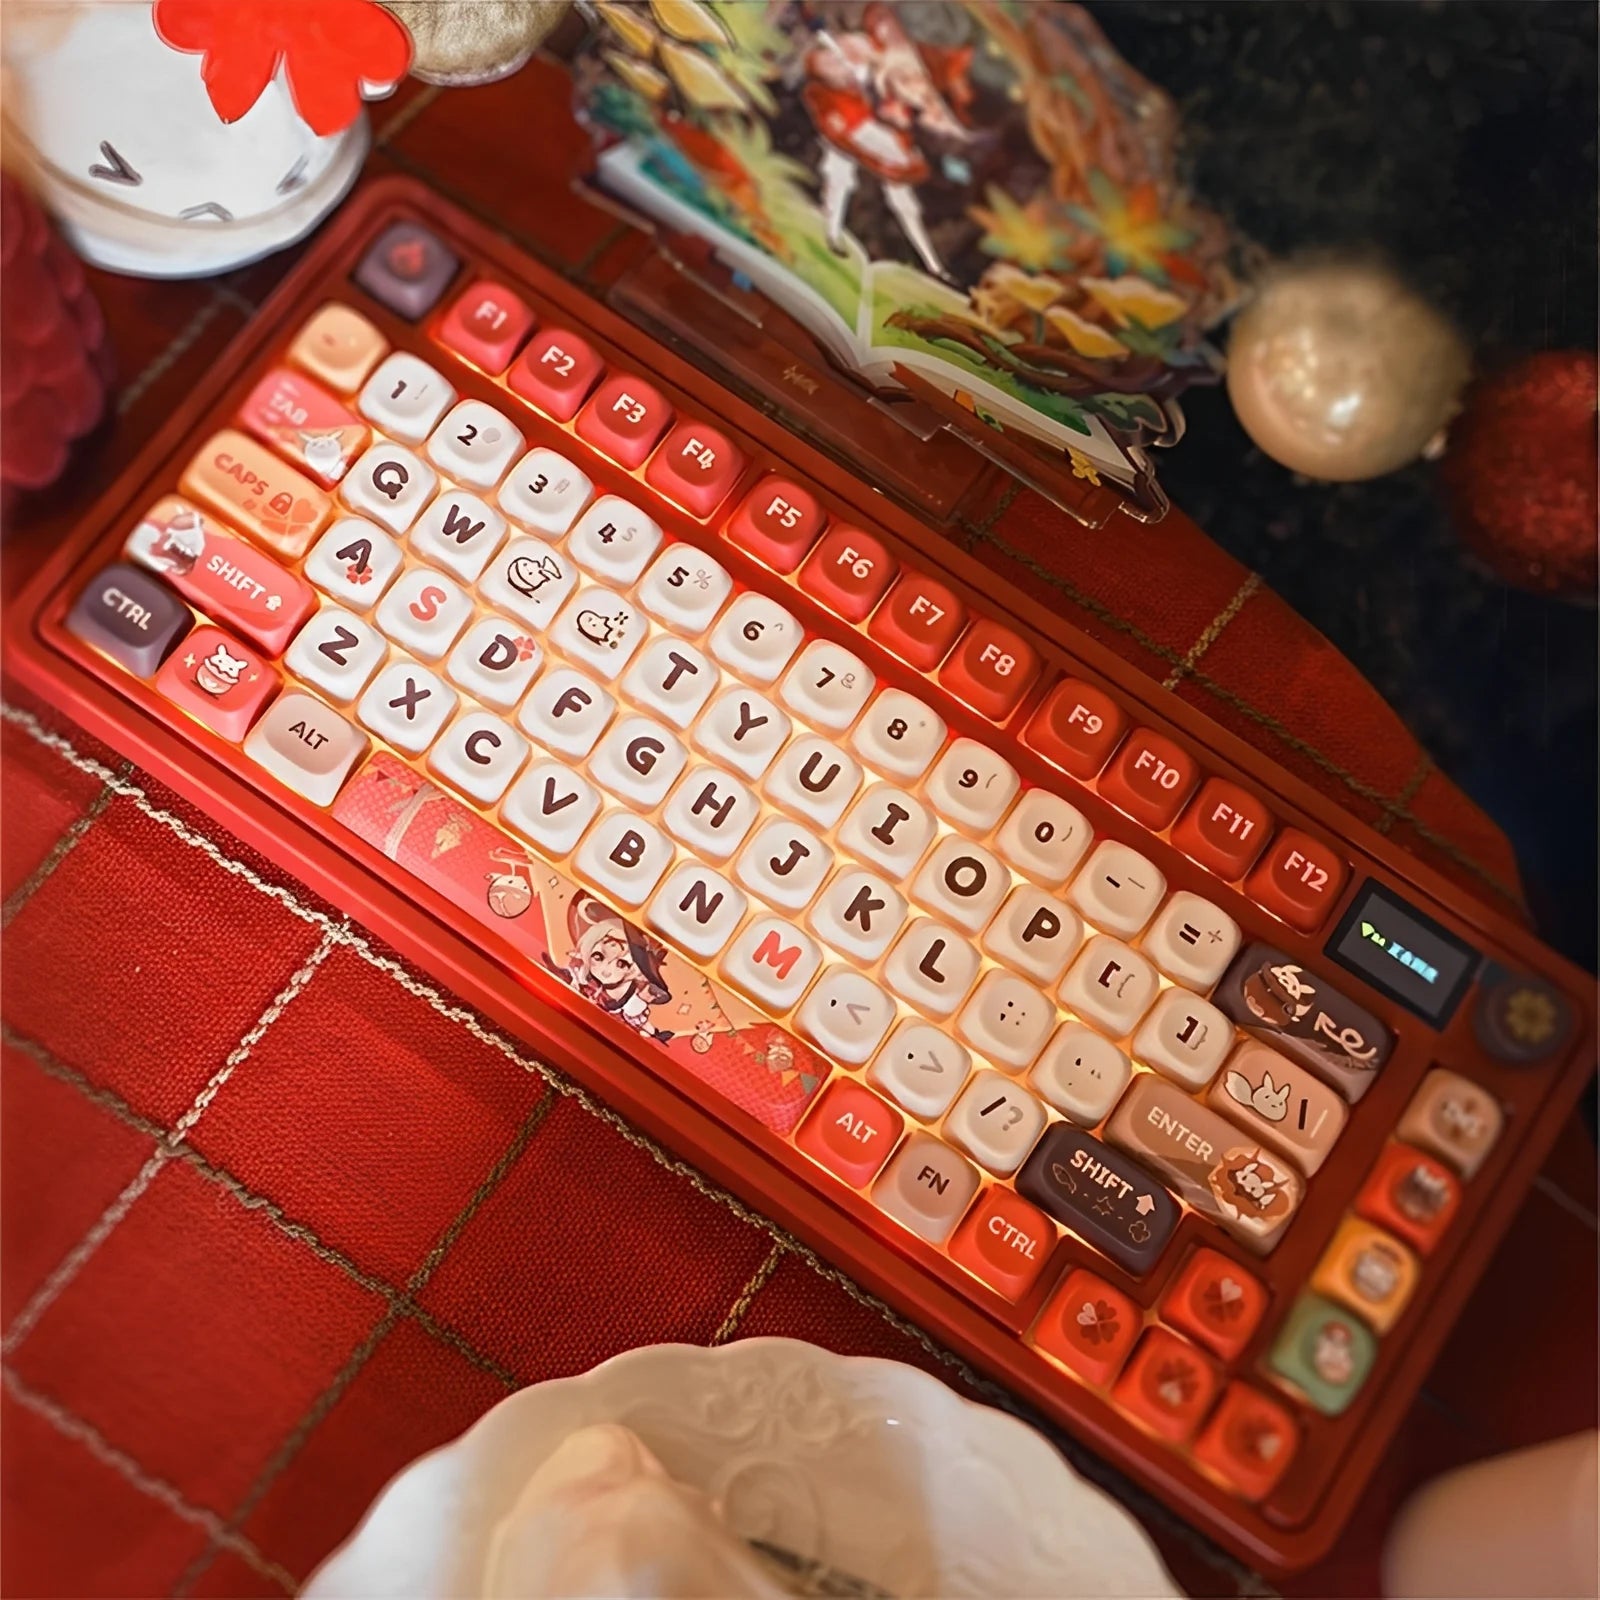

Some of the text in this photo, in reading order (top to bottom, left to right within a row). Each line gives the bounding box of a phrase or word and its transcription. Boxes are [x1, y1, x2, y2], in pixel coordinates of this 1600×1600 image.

[474, 302, 507, 331] F1
[540, 346, 575, 377] F2
[391, 380, 407, 399] 1
[269, 392, 309, 425] TAB
[613, 393, 647, 424] F3
[456, 424, 477, 446] 2
[681, 438, 715, 470] F4
[214, 453, 270, 497] CAPS
[372, 461, 409, 500] Q
[529, 475, 549, 495] 3
[440, 504, 486, 545] W
[766, 497, 802, 528] F5
[598, 523, 615, 544] 4
[337, 538, 372, 573] A
[836, 547, 874, 579] F6
[206, 554, 267, 600] SHIFT
[667, 566, 690, 588] 5
[102, 587, 152, 632] CTRL
[409, 586, 446, 622] S
[909, 596, 946, 627] F7
[318, 625, 359, 667] Z
[743, 620, 765, 641] 6
[479, 634, 518, 671] D
[979, 643, 1016, 677] F8
[662, 651, 698, 691] T
[815, 667, 836, 688] 7
[389, 677, 432, 720] X
[551, 687, 592, 718] F
[288, 720, 329, 751] ALT
[733, 702, 769, 742] Y
[886, 719, 908, 740] 8
[1067, 704, 1104, 735] F9
[465, 730, 502, 765] C
[626, 736, 665, 776] G
[799, 751, 841, 793] U
[958, 769, 979, 788] 9
[1134, 749, 1181, 790] F10
[541, 777, 579, 816] V
[691, 781, 736, 828] H
[871, 802, 910, 846] I
[1034, 821, 1054, 843] 0
[1211, 802, 1255, 842] F11
[609, 829, 646, 868] B
[769, 839, 811, 876] J
[944, 856, 988, 897] O
[1283, 851, 1329, 892] F12
[678, 880, 724, 924] N
[844, 885, 886, 932] K
[1022, 907, 1062, 943] P
[1179, 922, 1201, 946] =
[752, 931, 802, 979] M
[919, 938, 947, 984] L
[835, 1111, 878, 1145] ALT
[1001, 1106, 1024, 1132] ?
[1147, 1106, 1214, 1162] ENTER
[917, 1165, 951, 1196] FN
[1069, 1149, 1134, 1200] SHIFT
[988, 1215, 1037, 1261] CTRL
